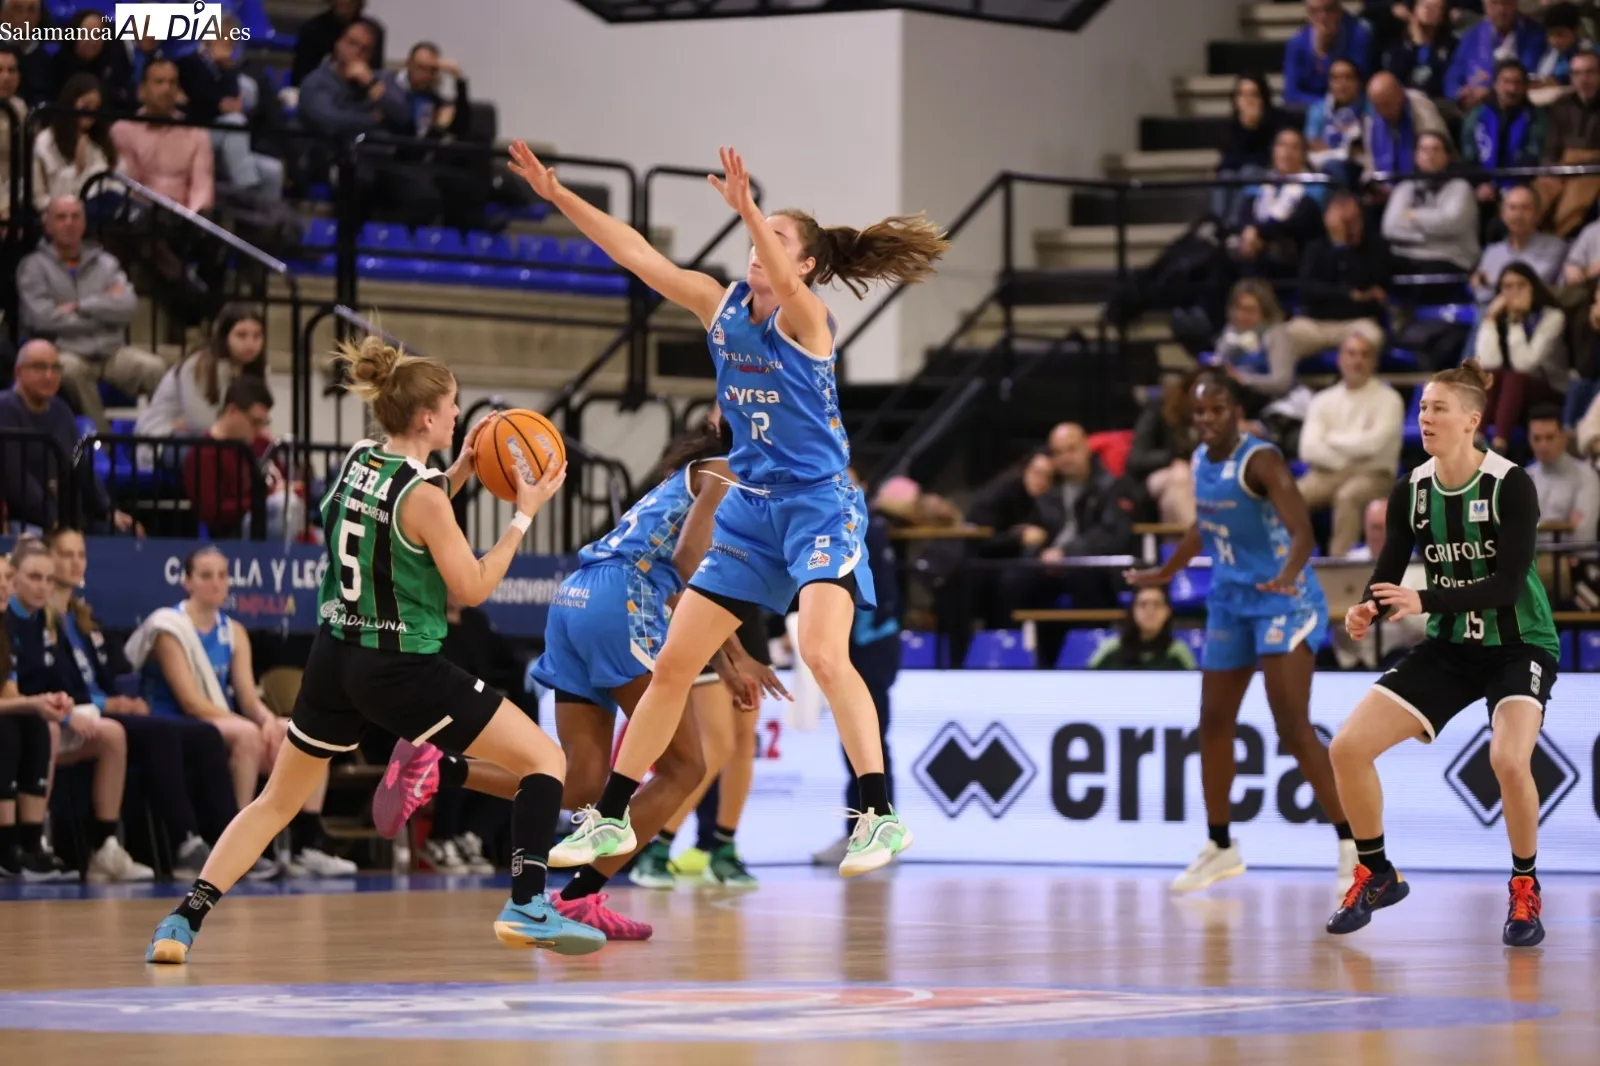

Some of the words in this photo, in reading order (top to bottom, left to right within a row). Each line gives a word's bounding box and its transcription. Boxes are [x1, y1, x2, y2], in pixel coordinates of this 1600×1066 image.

[337, 519, 366, 602] 5
[1424, 540, 1497, 563] GRIFOLS
[270, 558, 287, 594] Y
[292, 552, 331, 589] LEÓ
